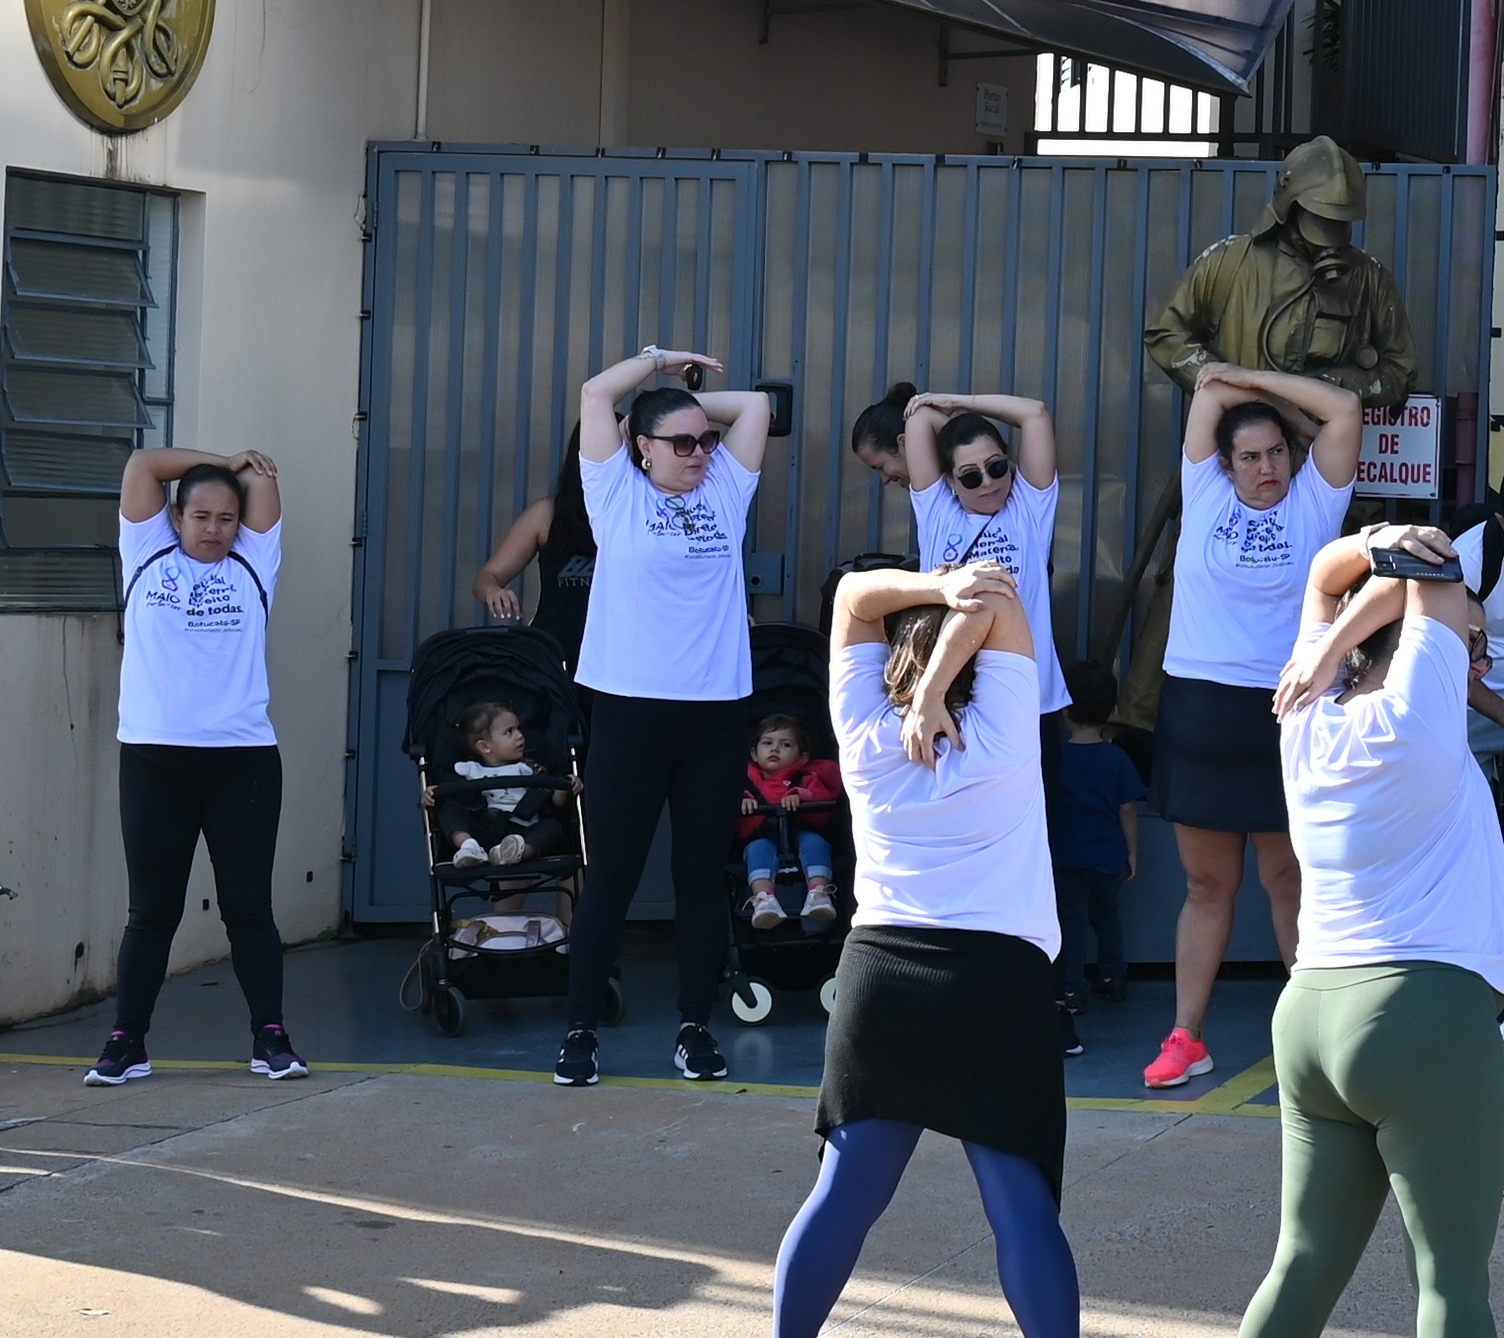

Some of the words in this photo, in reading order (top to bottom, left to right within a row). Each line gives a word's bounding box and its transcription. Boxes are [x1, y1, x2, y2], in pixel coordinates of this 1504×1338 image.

[1363, 405, 1431, 428] EGITRO
[1378, 433, 1400, 455] DE
[1357, 462, 1432, 485] ECALQUE
[146, 590, 181, 604] MAIO
[186, 608, 205, 617] de
